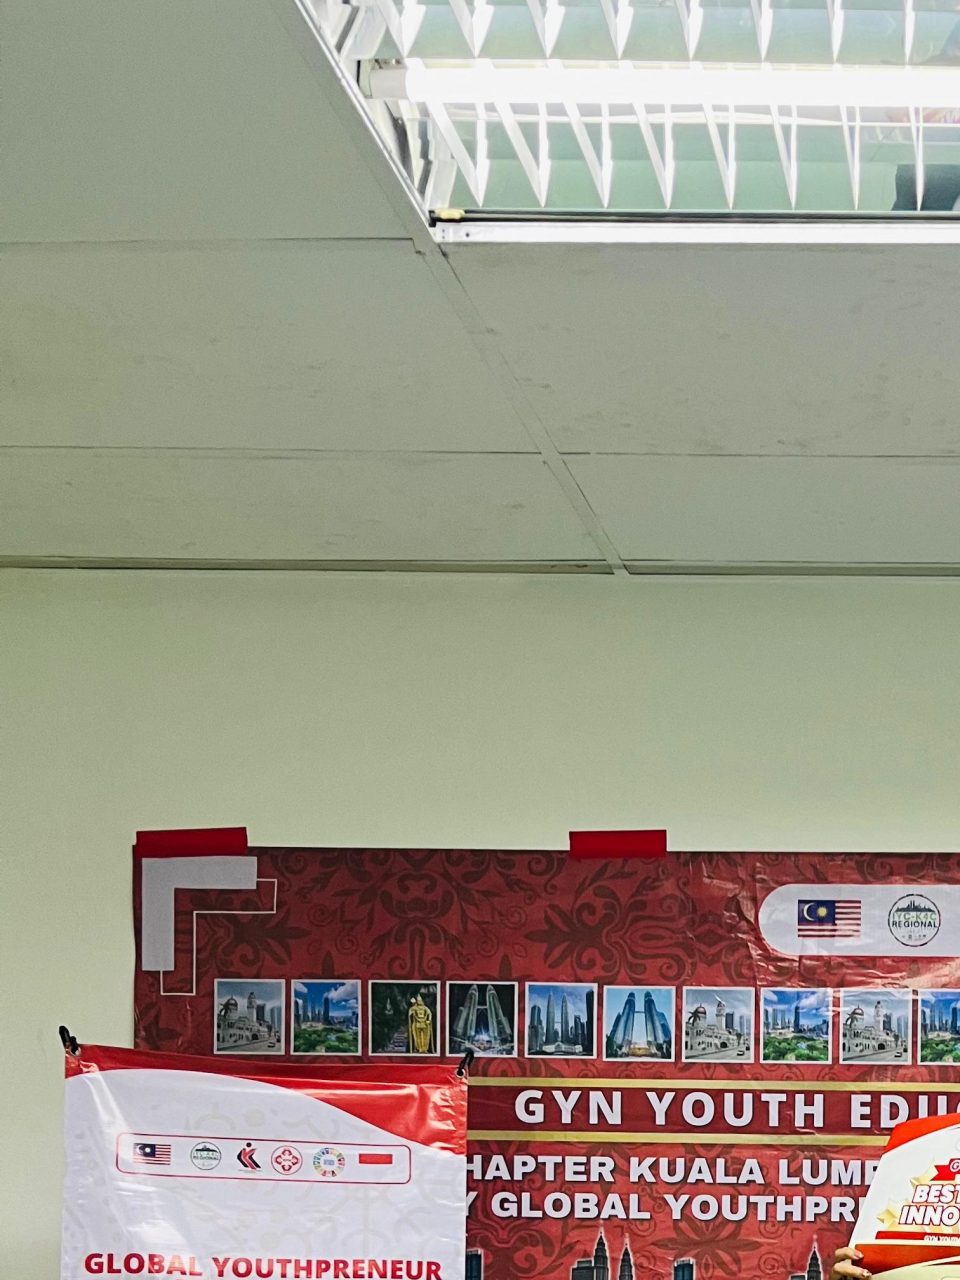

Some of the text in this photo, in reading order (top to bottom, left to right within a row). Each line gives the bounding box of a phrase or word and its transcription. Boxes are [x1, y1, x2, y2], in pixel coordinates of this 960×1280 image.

[892, 920, 938, 928] REGIONAL
[514, 1090, 623, 1125] GYN
[646, 1092, 825, 1128] YOUTH
[466, 1155, 614, 1182] HAPTER
[629, 1157, 765, 1185] KUALA
[491, 1191, 651, 1219] GLOBAL
[664, 1194, 866, 1222] YOUTHPR
[84, 1253, 443, 1280] GLOBAL YOUTHPRENEUR
